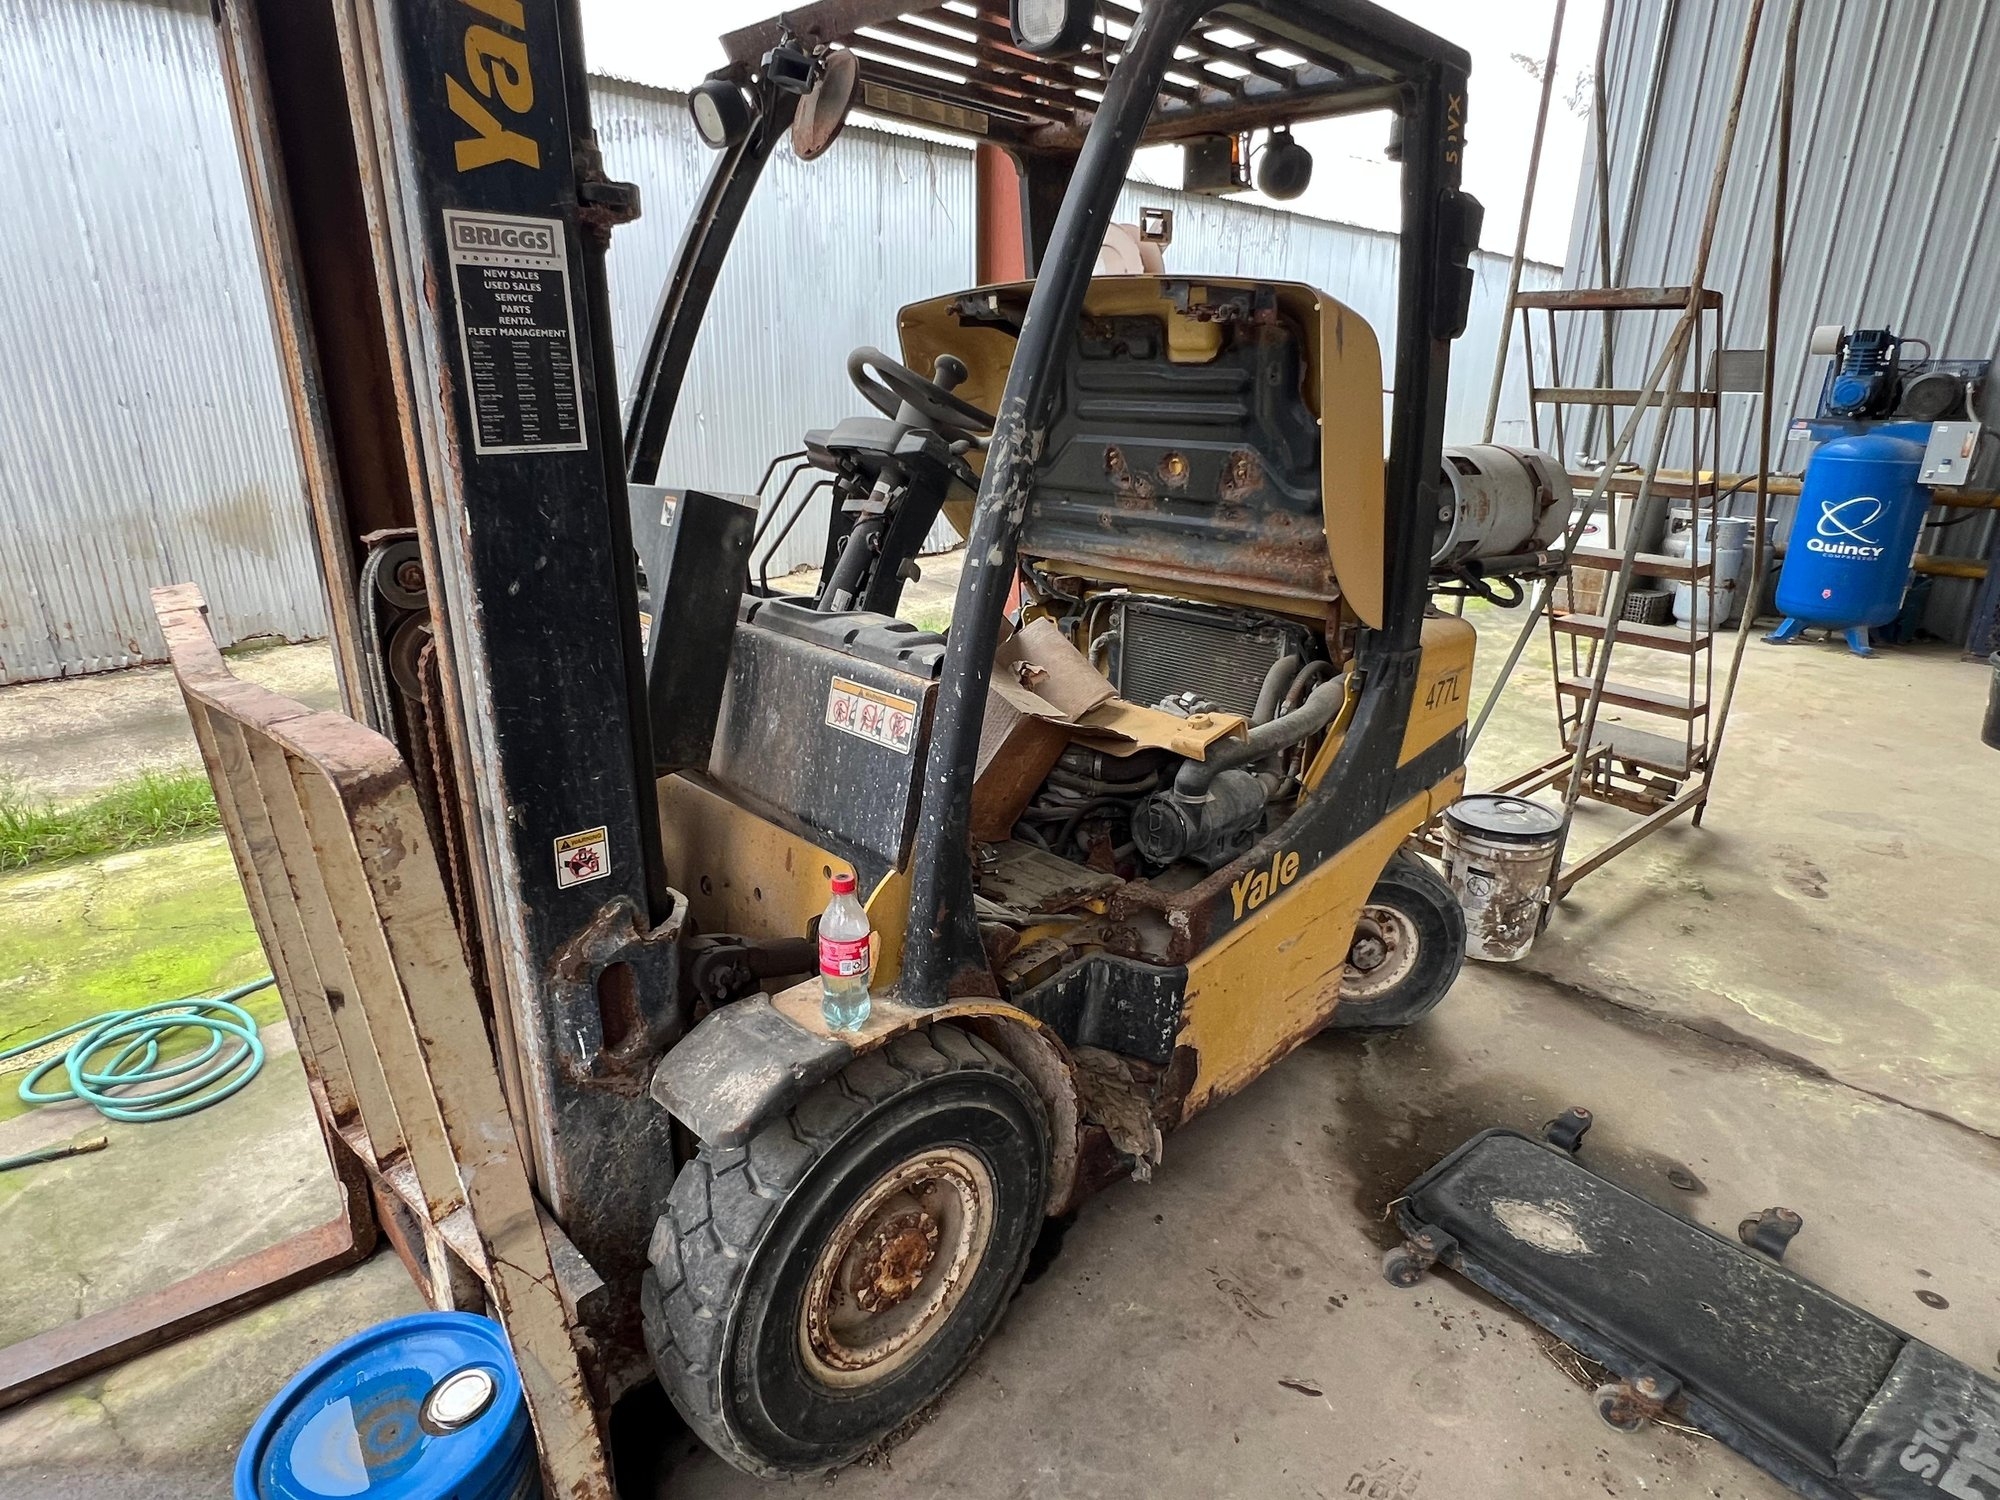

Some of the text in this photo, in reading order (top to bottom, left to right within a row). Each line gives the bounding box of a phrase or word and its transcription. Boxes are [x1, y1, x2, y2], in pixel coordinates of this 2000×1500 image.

[459, 225, 549, 250] BRIGGS
[462, 254, 551, 265] EQUIPMENT
[483, 269, 540, 280] NEW SALES
[483, 281, 542, 292] USED SALES
[495, 293, 534, 303] SERVICE
[501, 305, 531, 314] PARTS
[499, 316, 536, 326] RENTAL
[467, 327, 567, 338] FLEET MANAGEMENT
[1807, 538, 1884, 556] Quincy
[1822, 553, 1878, 561] COMPRESSOR
[1425, 675, 1460, 710] 477L
[1231, 850, 1300, 921] Yale
